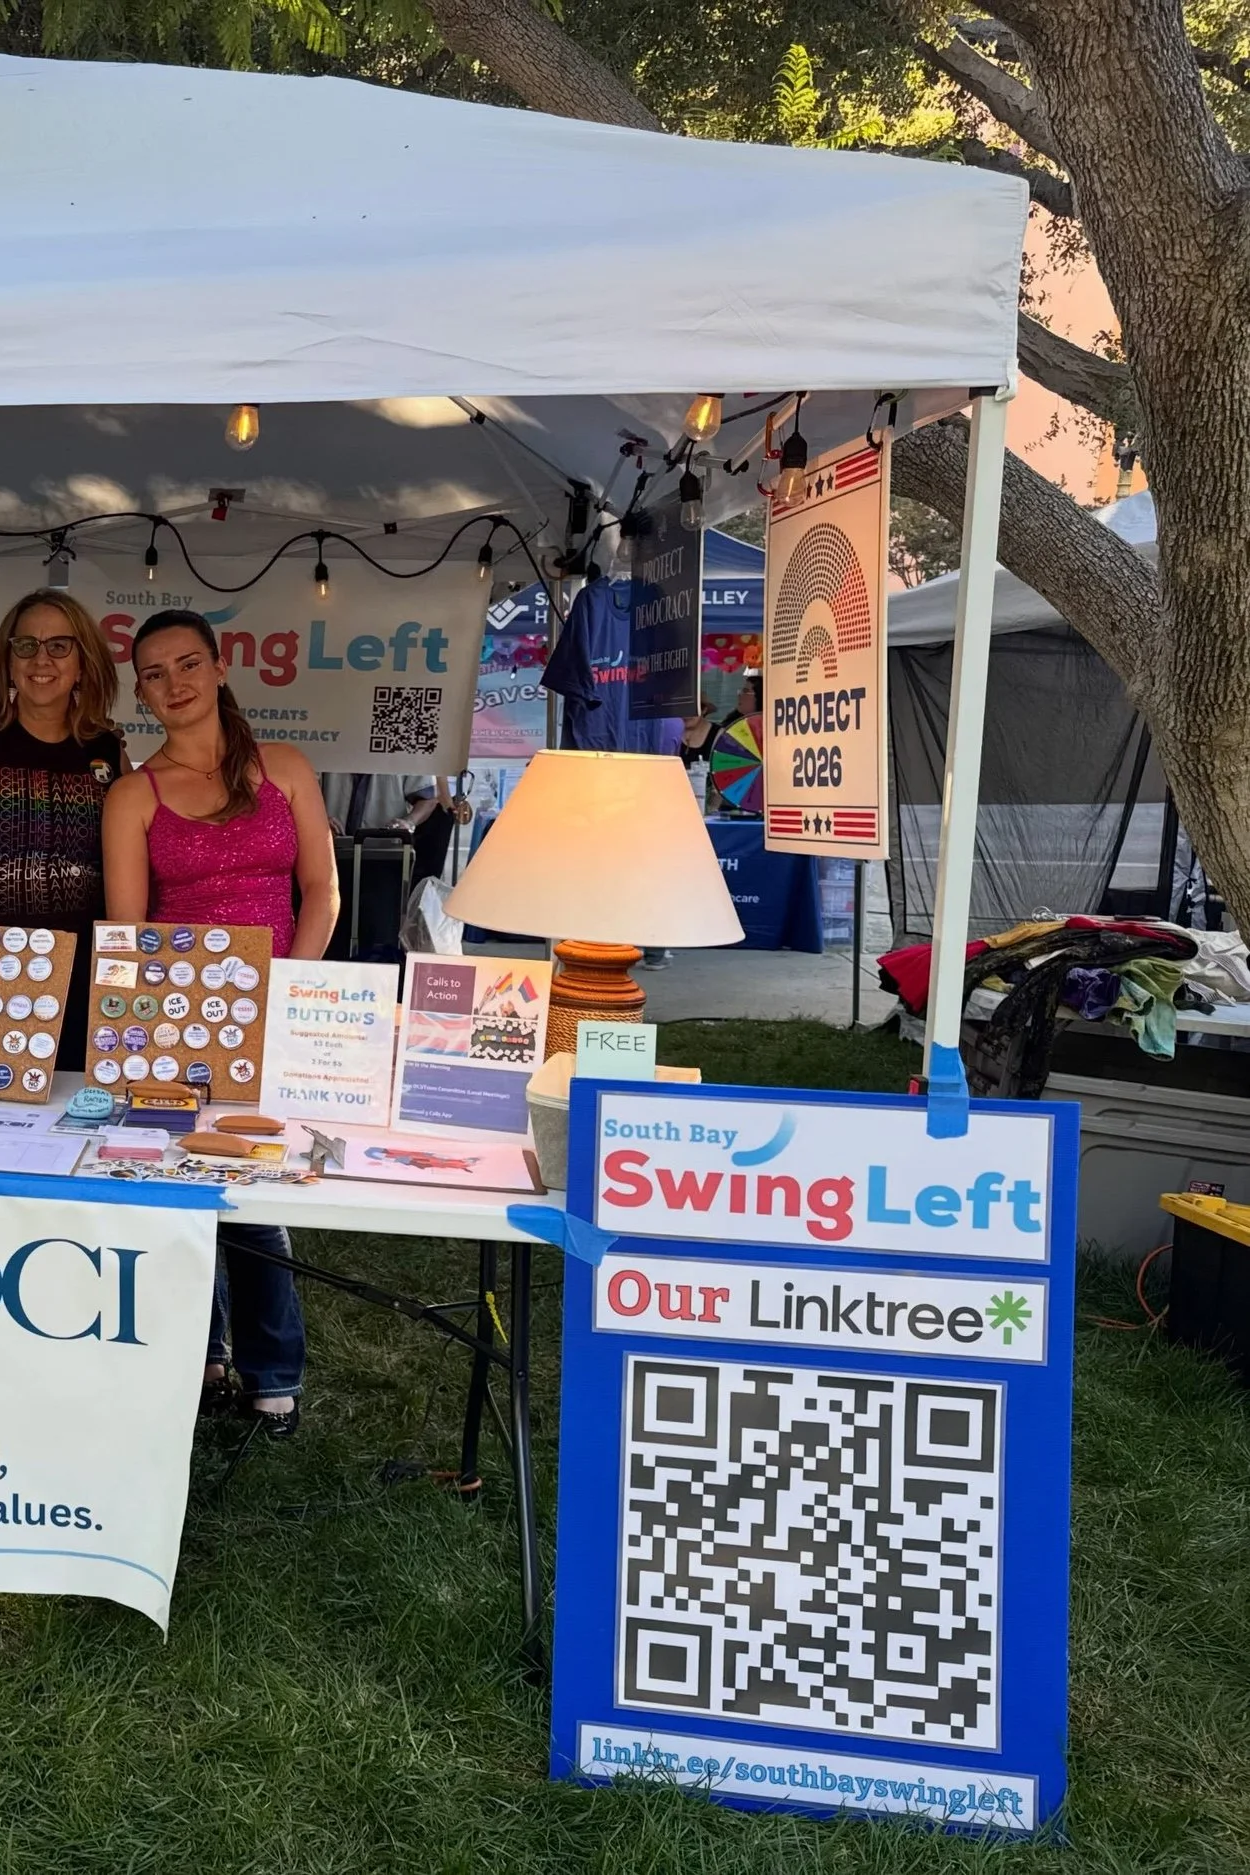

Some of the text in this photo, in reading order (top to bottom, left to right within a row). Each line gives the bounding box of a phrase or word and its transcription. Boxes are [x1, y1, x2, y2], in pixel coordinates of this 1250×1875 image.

[643, 546, 685, 587] PROTECT
[105, 590, 194, 609] South Bay
[636, 588, 694, 631] DEMOCRACY
[308, 620, 449, 675] Left
[650, 648, 689, 672] THE FIGHT!
[774, 687, 866, 737] PROJECT
[793, 745, 841, 788] 2026
[29, 790, 49, 801] LIKE
[53, 793, 62, 803] A
[30, 801, 50, 812] LIKE
[54, 805, 63, 813] A
[25, 868, 46, 880] LIKE
[49, 869, 59, 879] A
[25, 879, 47, 891] LIKE
[51, 880, 60, 890] A
[427, 976, 461, 988] Calls to
[168, 996, 182, 1006] ICE
[288, 985, 376, 1003] Swing Left
[427, 990, 458, 1001] Action
[168, 1005, 186, 1015] OUT
[206, 1009, 224, 1019] OUT
[207, 1000, 221, 1009] ICE
[287, 1006, 375, 1026] BUTTONS
[584, 1030, 647, 1053] FREE
[240, 1070, 251, 1079] NO
[28, 1081, 39, 1089] NO
[278, 1086, 372, 1106] THANK YOU!
[604, 1118, 739, 1151] South Bay
[601, 1149, 1043, 1242] Swing Left
[607, 1270, 985, 1344] Our Linktree
[592, 1736, 1023, 1818] linktr.ee/southbayswingleft
